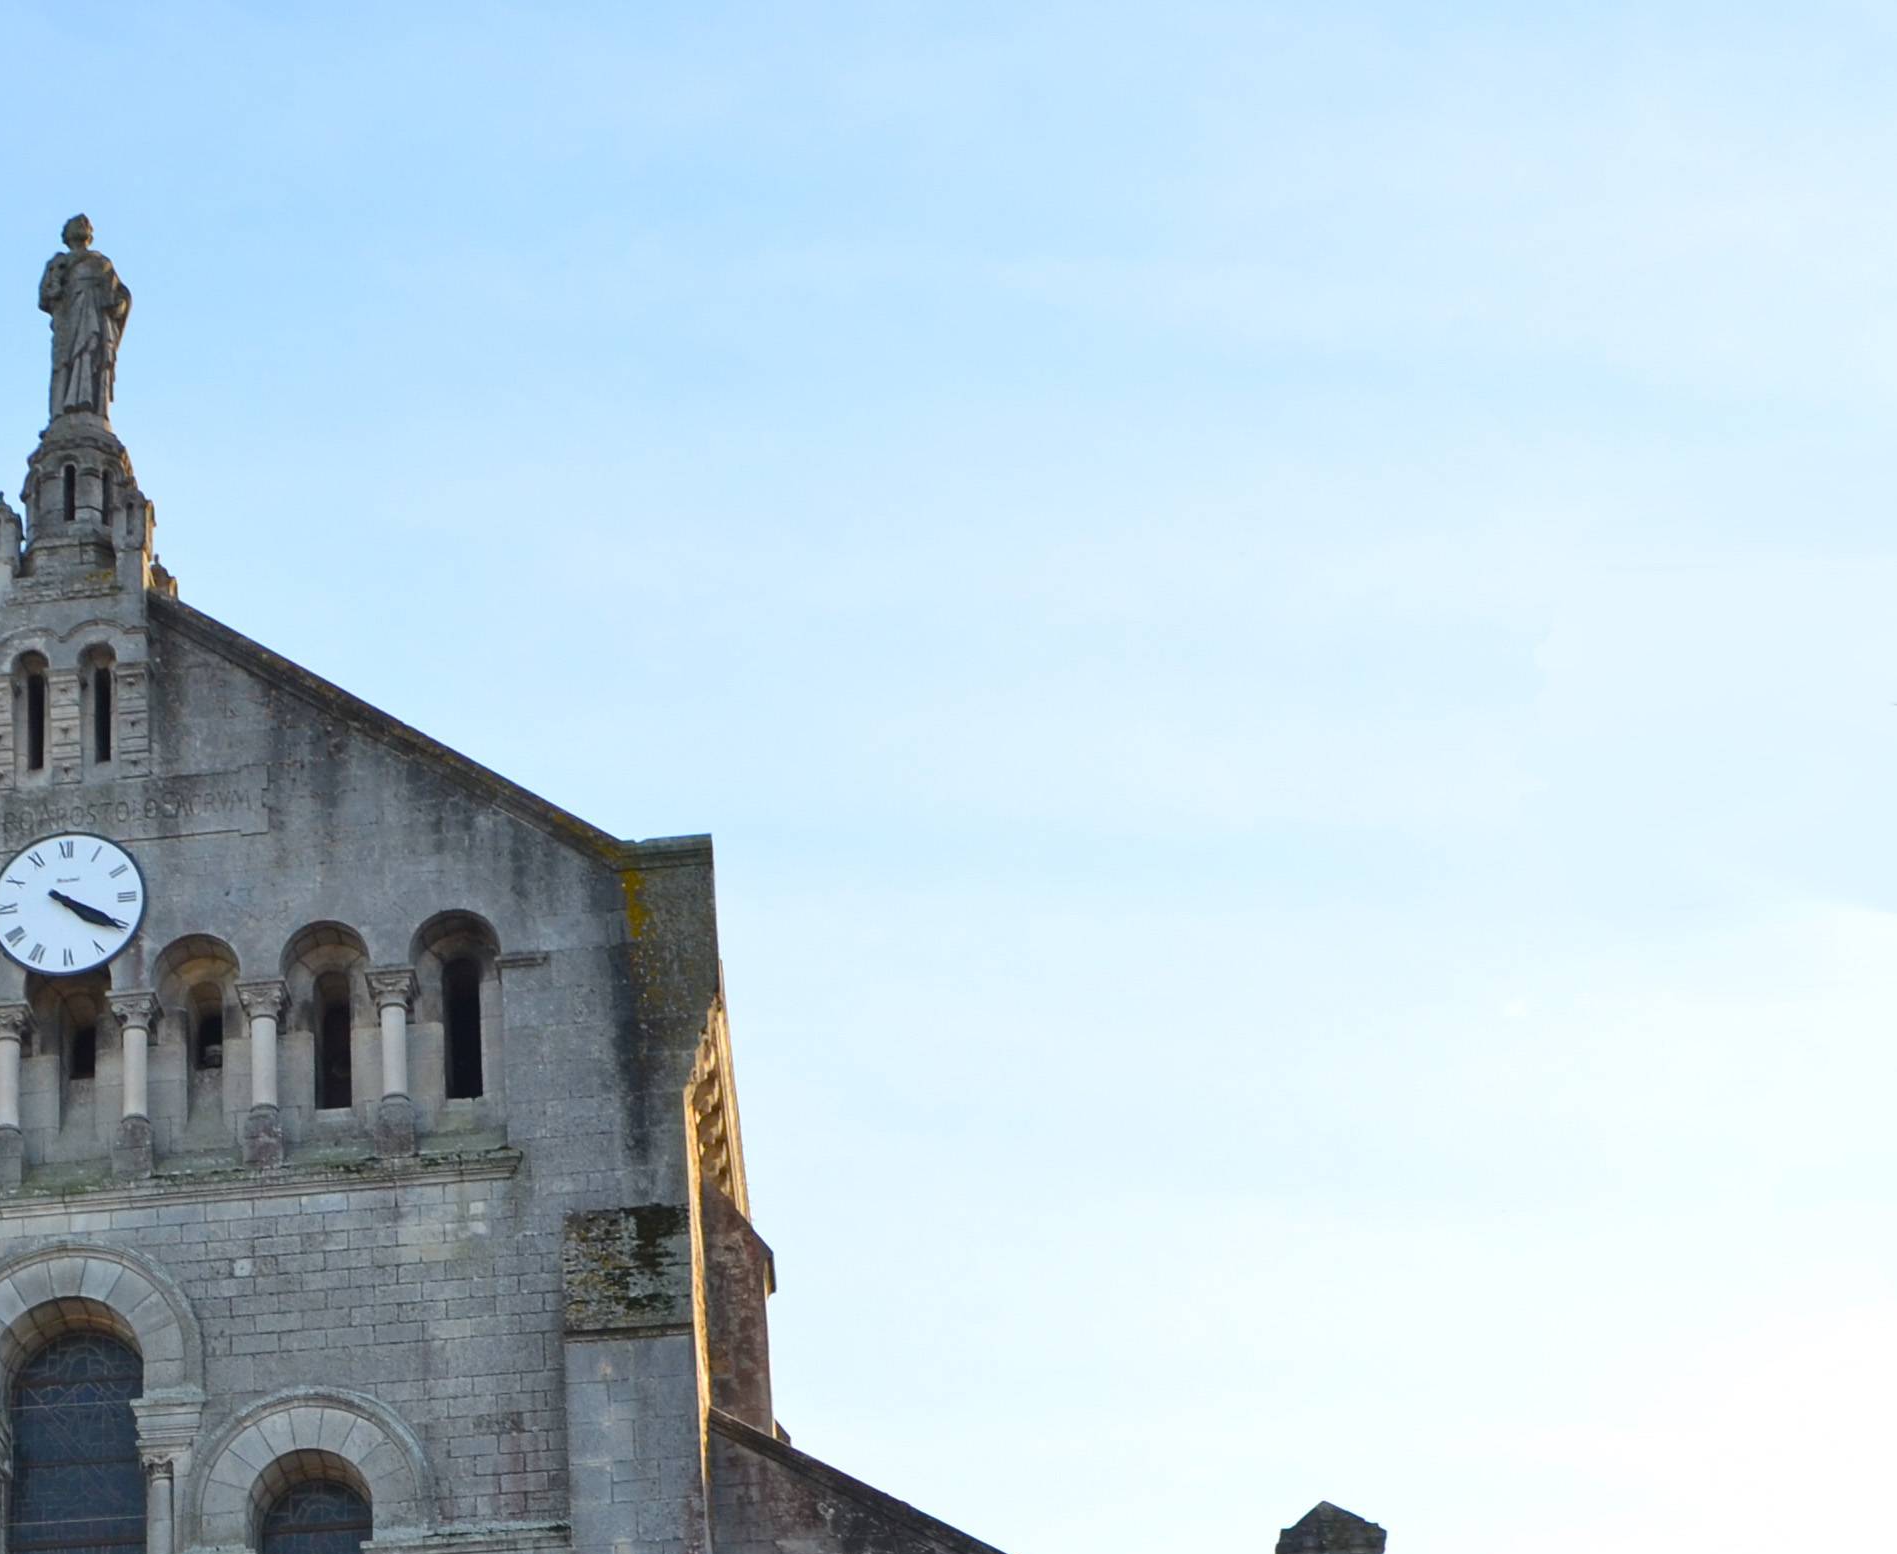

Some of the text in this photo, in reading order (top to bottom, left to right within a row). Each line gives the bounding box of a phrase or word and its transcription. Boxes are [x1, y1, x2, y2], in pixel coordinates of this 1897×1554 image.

[59, 841, 73, 859] XII
[28, 851, 45, 871] XI
[5, 875, 25, 889] X
[117, 891, 137, 903] III
